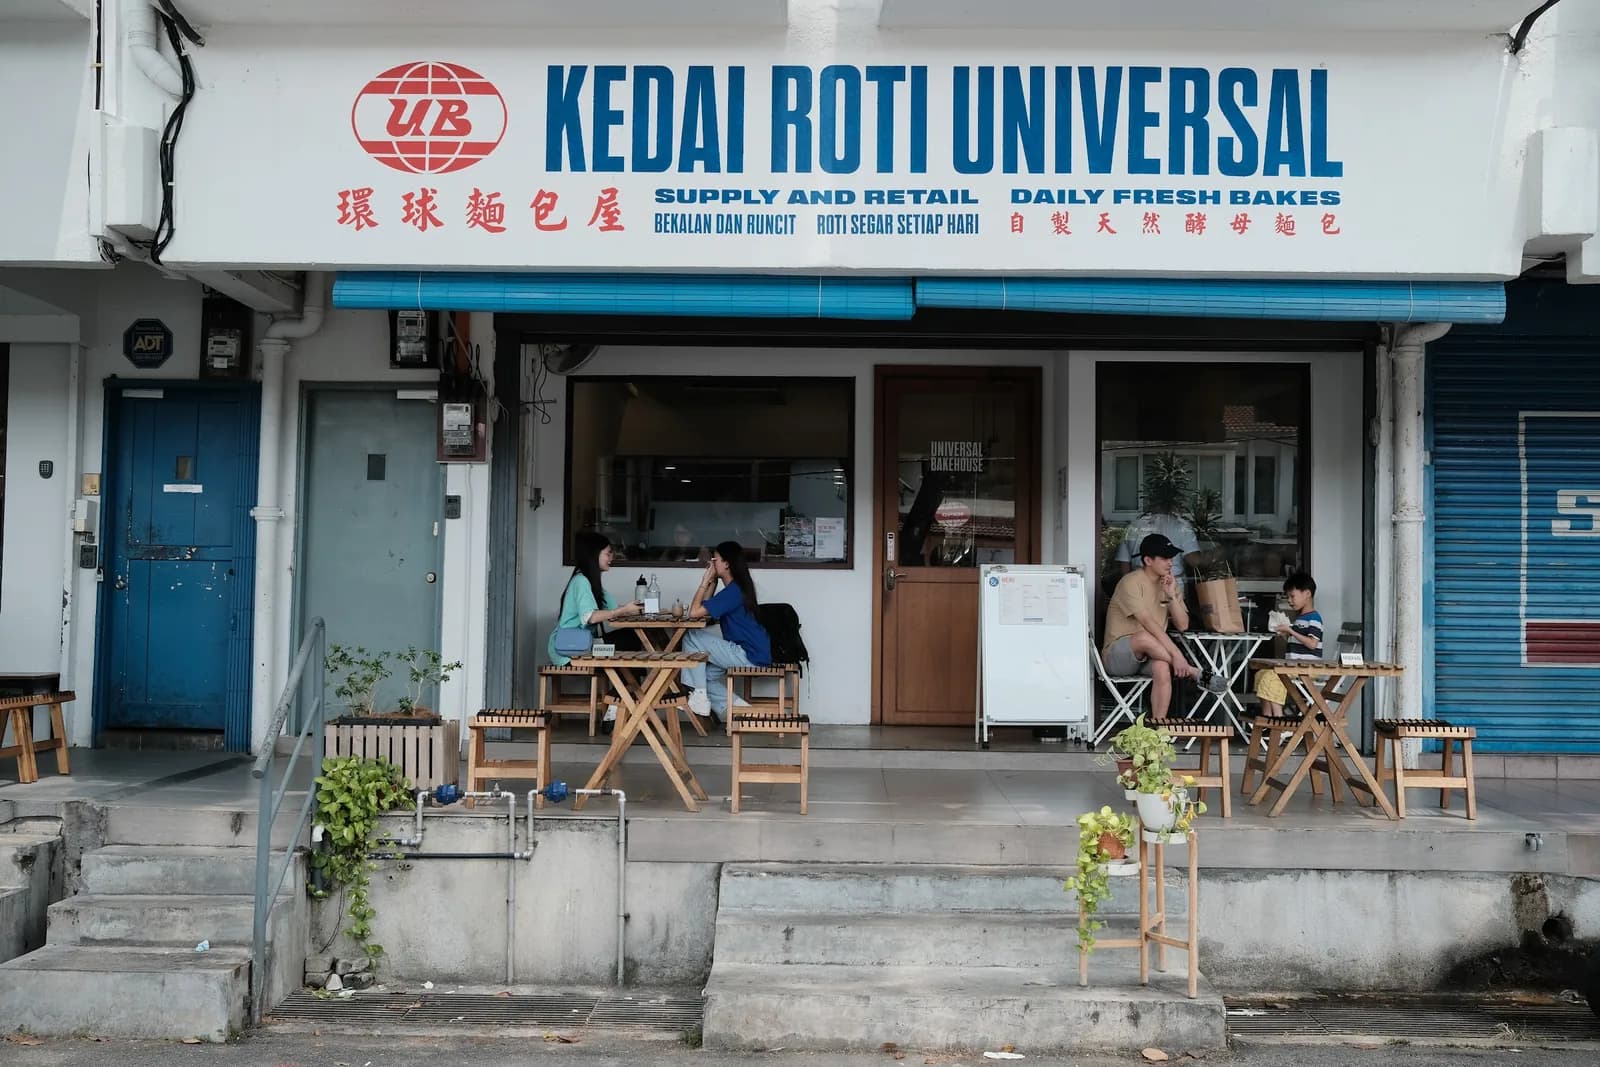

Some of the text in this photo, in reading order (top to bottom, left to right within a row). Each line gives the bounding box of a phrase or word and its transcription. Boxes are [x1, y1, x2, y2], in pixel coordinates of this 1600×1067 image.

[385, 98, 473, 139] UB
[545, 64, 1345, 178] KEDAI ROTI UNIVERSAL
[655, 188, 978, 206] SUPPLY AND RETAIL
[1010, 188, 1341, 207] DAILY FRESH BAKES
[336, 186, 625, 234] 環球麵包屋
[654, 213, 796, 236] BEKALAN DAN RUNCIT
[816, 213, 980, 236] ROTI SEGAR SETIAP HARI
[1010, 211, 1341, 236] 自製天然酵母麵包
[134, 335, 165, 351] ADT
[930, 440, 984, 457] UNIVERSAL
[930, 457, 984, 472] BAKEHOUSE
